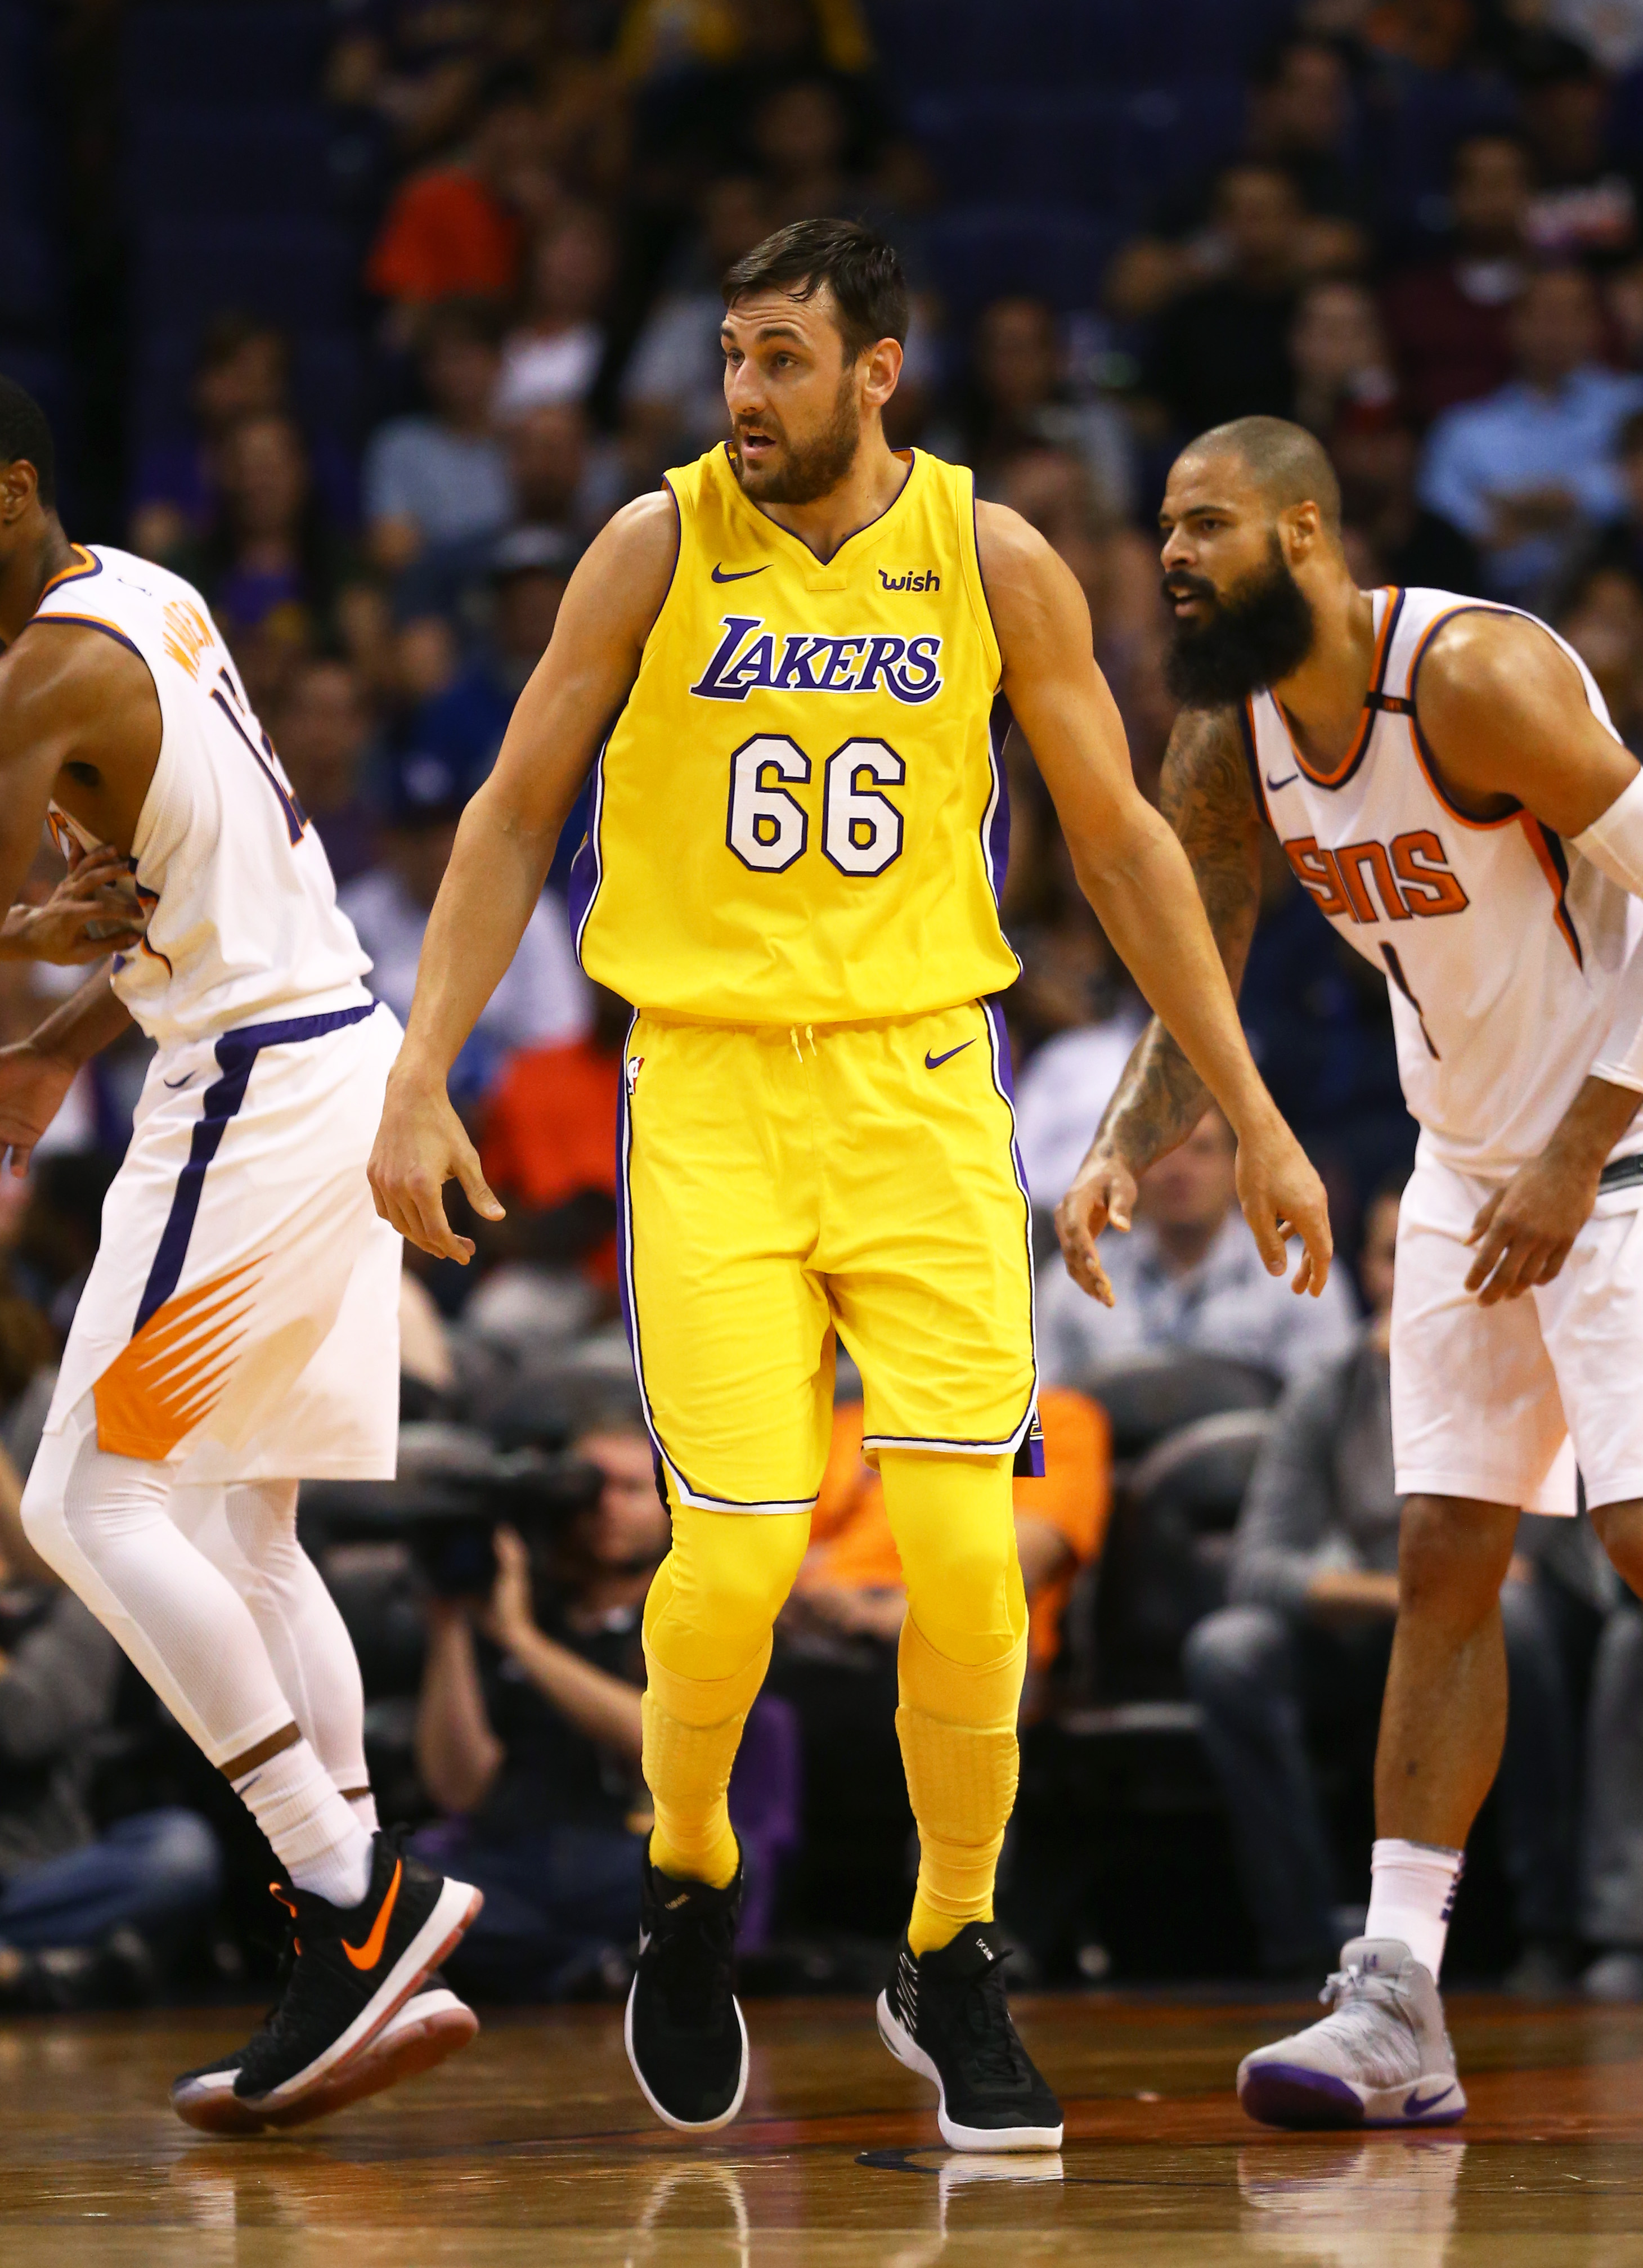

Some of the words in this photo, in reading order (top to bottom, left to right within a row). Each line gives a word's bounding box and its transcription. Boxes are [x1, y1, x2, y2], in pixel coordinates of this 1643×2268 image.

[878, 569, 940, 592] wish
[689, 614, 944, 707] LAKERS
[725, 733, 905, 877] 66
